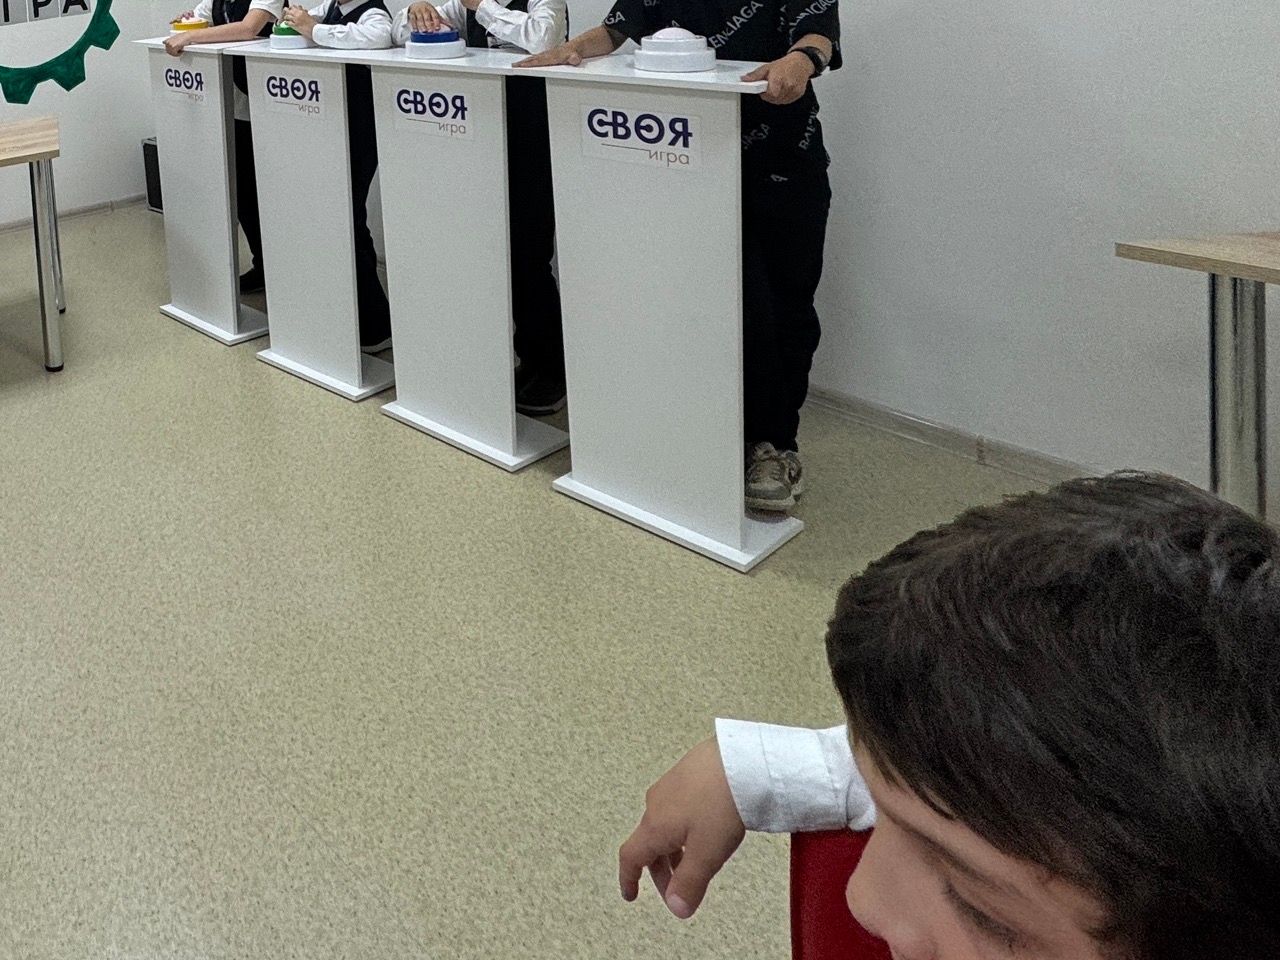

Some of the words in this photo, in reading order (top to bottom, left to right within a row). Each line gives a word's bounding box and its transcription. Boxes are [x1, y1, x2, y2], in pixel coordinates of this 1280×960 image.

[266, 76, 320, 102] СВОЯ
[396, 89, 468, 121] СВОЯ
[438, 121, 466, 135] игра
[587, 108, 693, 148] СВОЯ
[648, 150, 690, 167] игра
